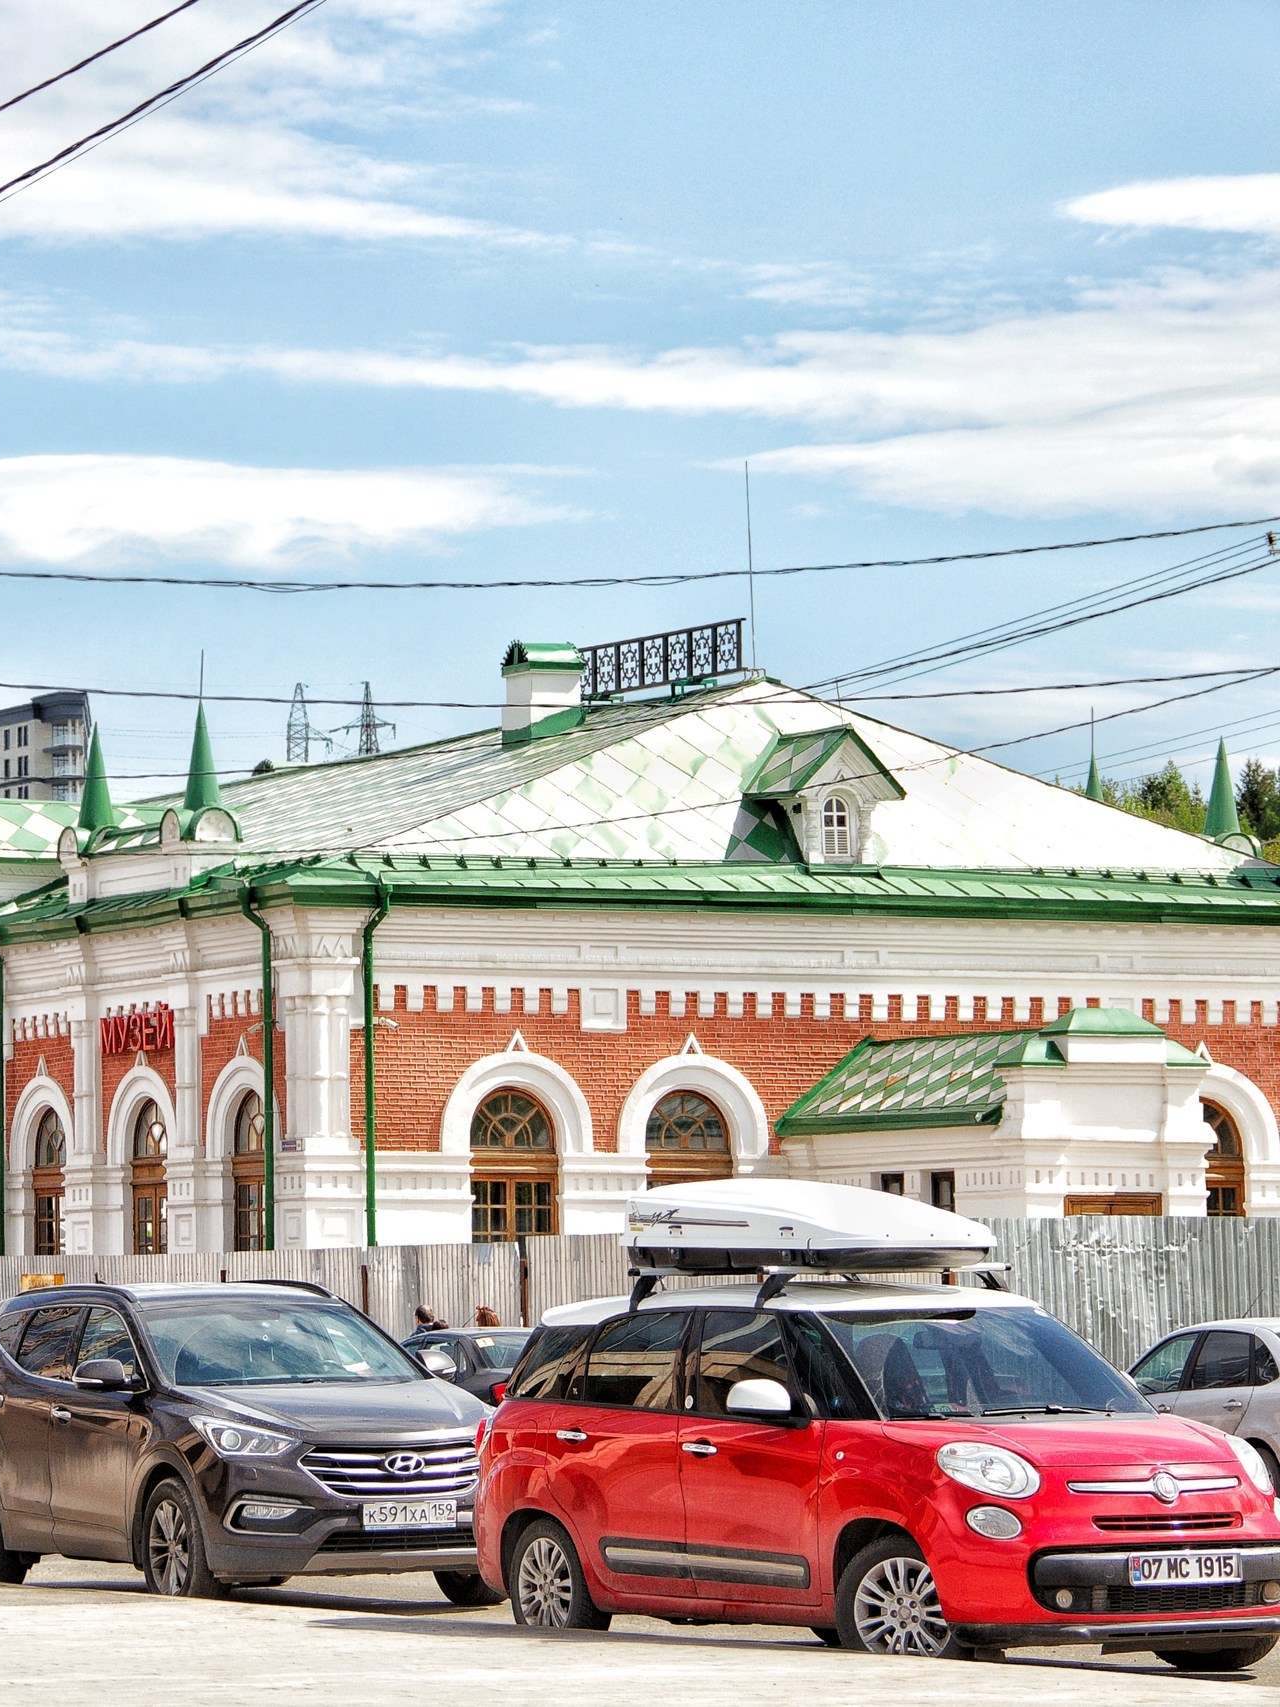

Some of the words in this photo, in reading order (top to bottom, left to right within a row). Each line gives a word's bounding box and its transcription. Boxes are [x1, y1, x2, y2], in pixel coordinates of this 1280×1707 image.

[99, 1003, 174, 1054] МУЗЕЙ
[368, 1505, 428, 1523] К591ХА
[431, 1503, 453, 1516] 159
[1141, 1558, 1163, 1580] 07
[1166, 1557, 1190, 1578] MC
[1195, 1555, 1234, 1577] 1915
